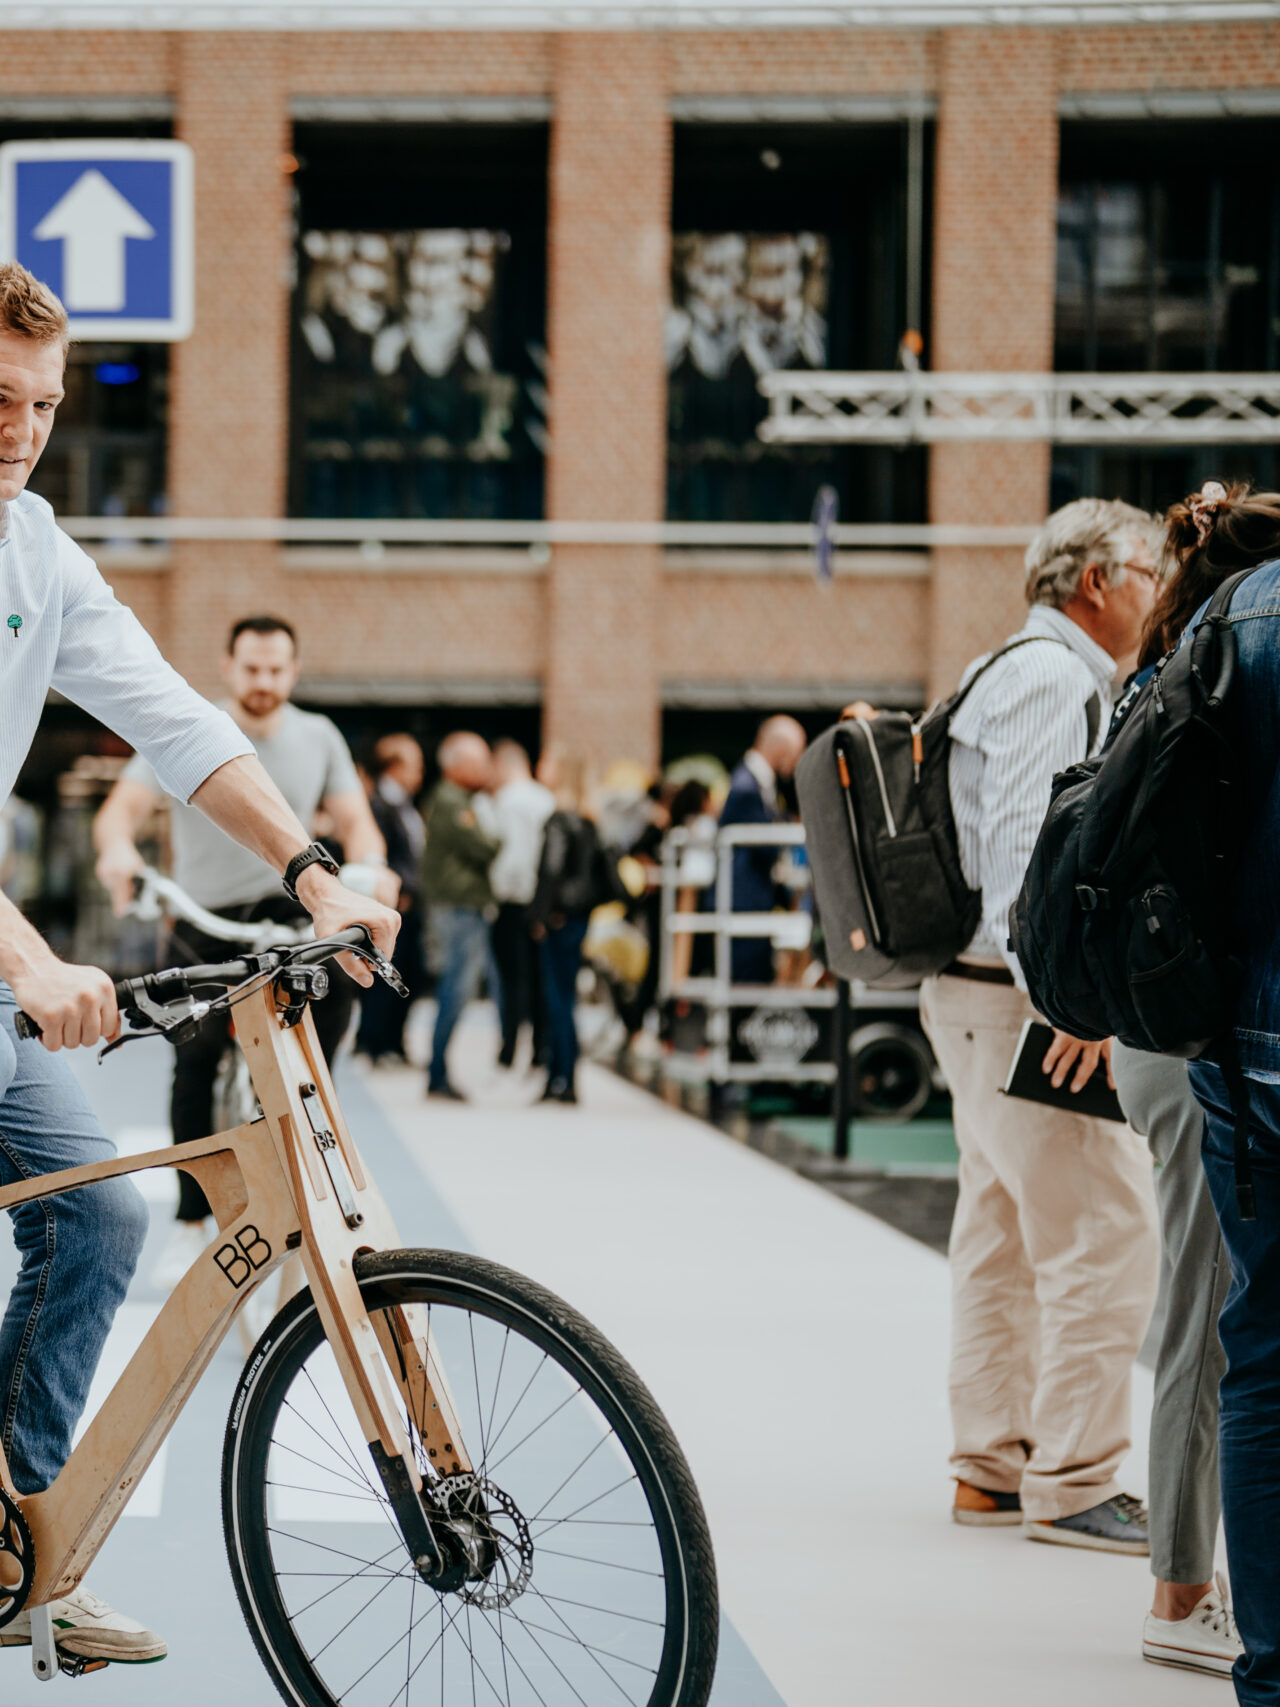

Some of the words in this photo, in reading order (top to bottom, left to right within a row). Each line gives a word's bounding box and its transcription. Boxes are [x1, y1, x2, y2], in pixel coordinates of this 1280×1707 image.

[313, 1130, 336, 1151] BB
[213, 1224, 272, 1289] BB
[244, 1353, 264, 1387] PROTEK
